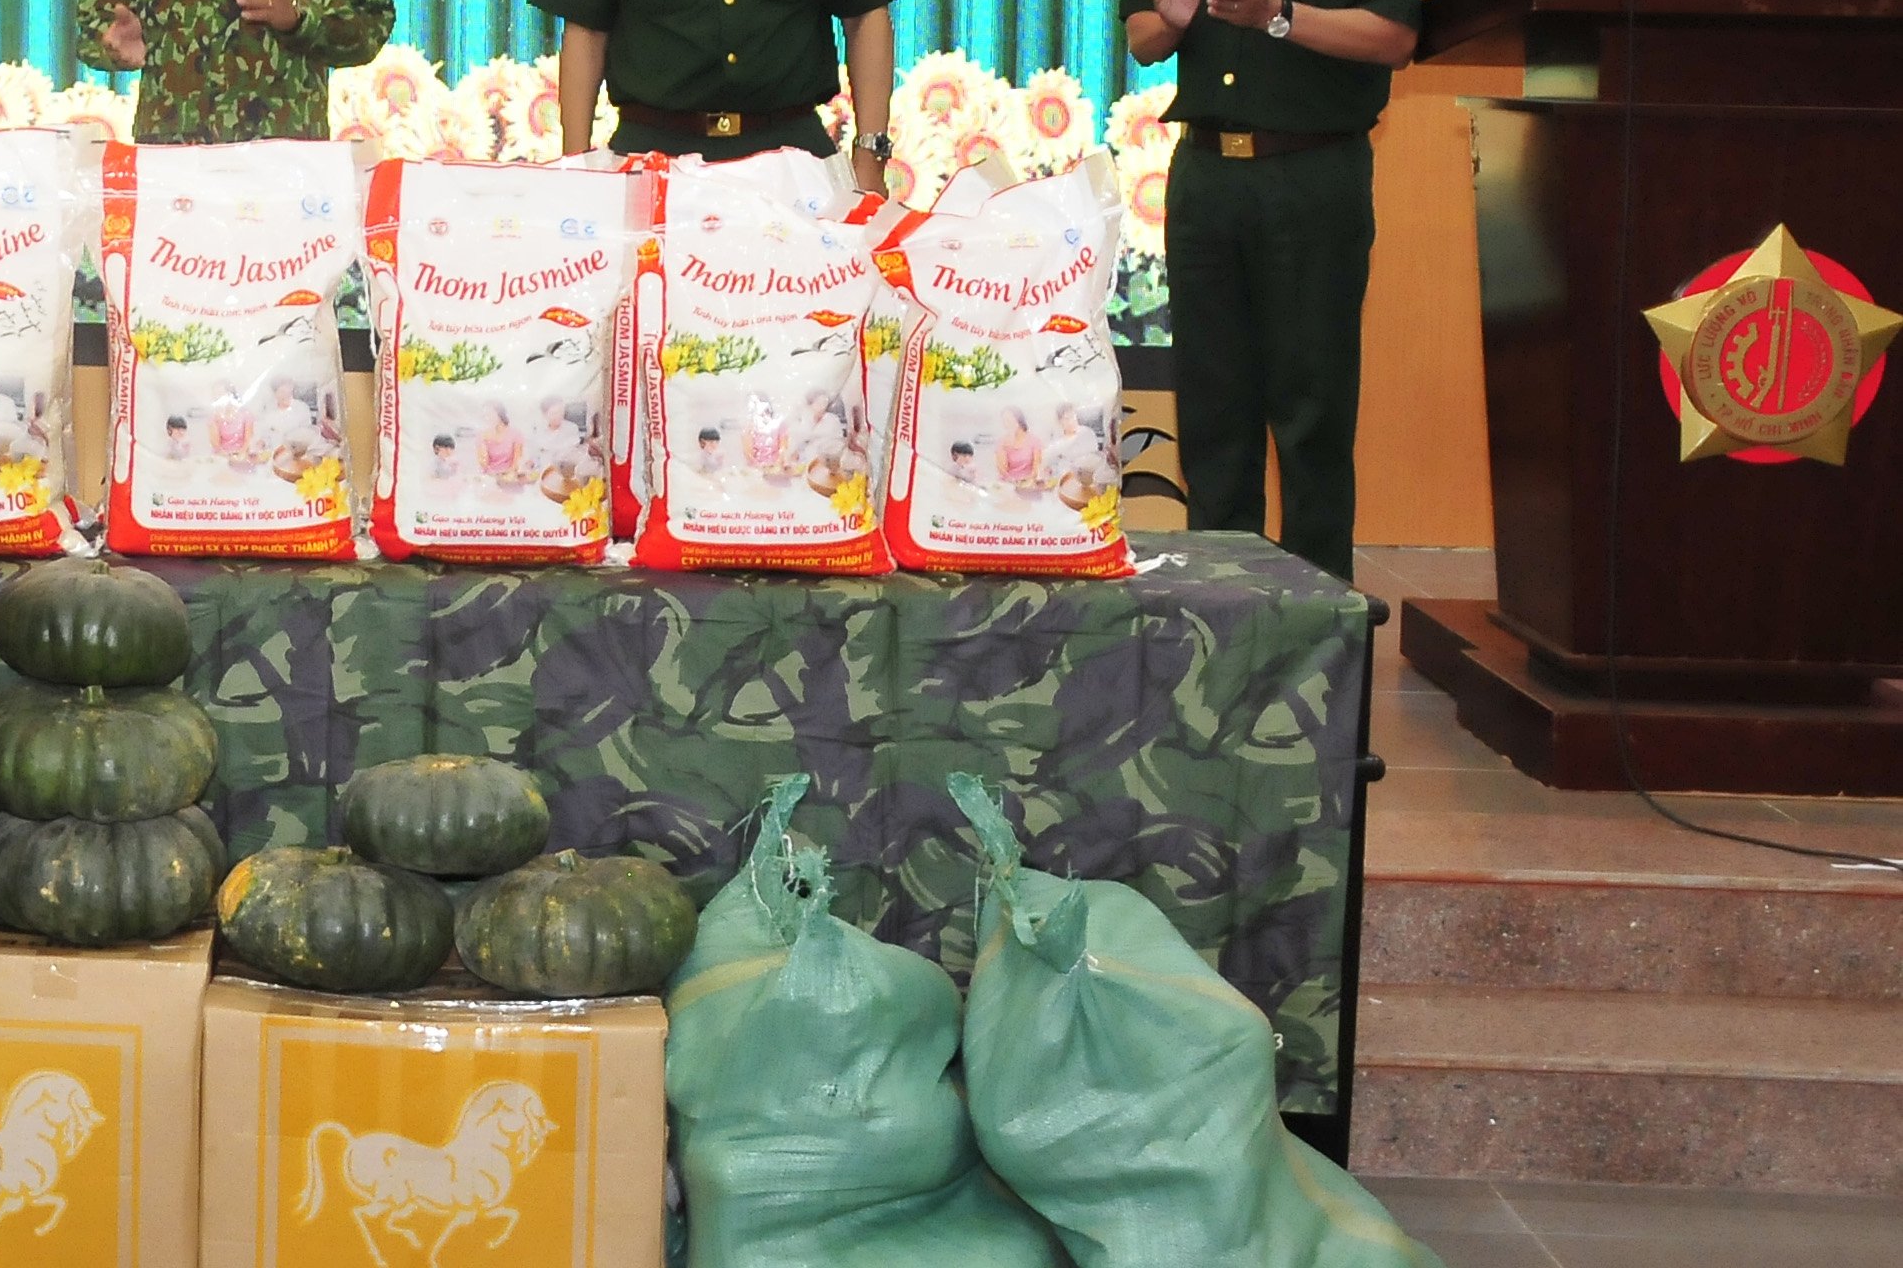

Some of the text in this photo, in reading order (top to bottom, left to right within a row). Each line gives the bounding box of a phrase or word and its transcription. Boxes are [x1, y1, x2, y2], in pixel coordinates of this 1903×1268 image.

[149, 234, 337, 286] Thơm Jasmine
[413, 249, 609, 304] Thơm Jasmine
[760, 255, 867, 295] Jasmine
[617, 344, 630, 407] JASMINE
